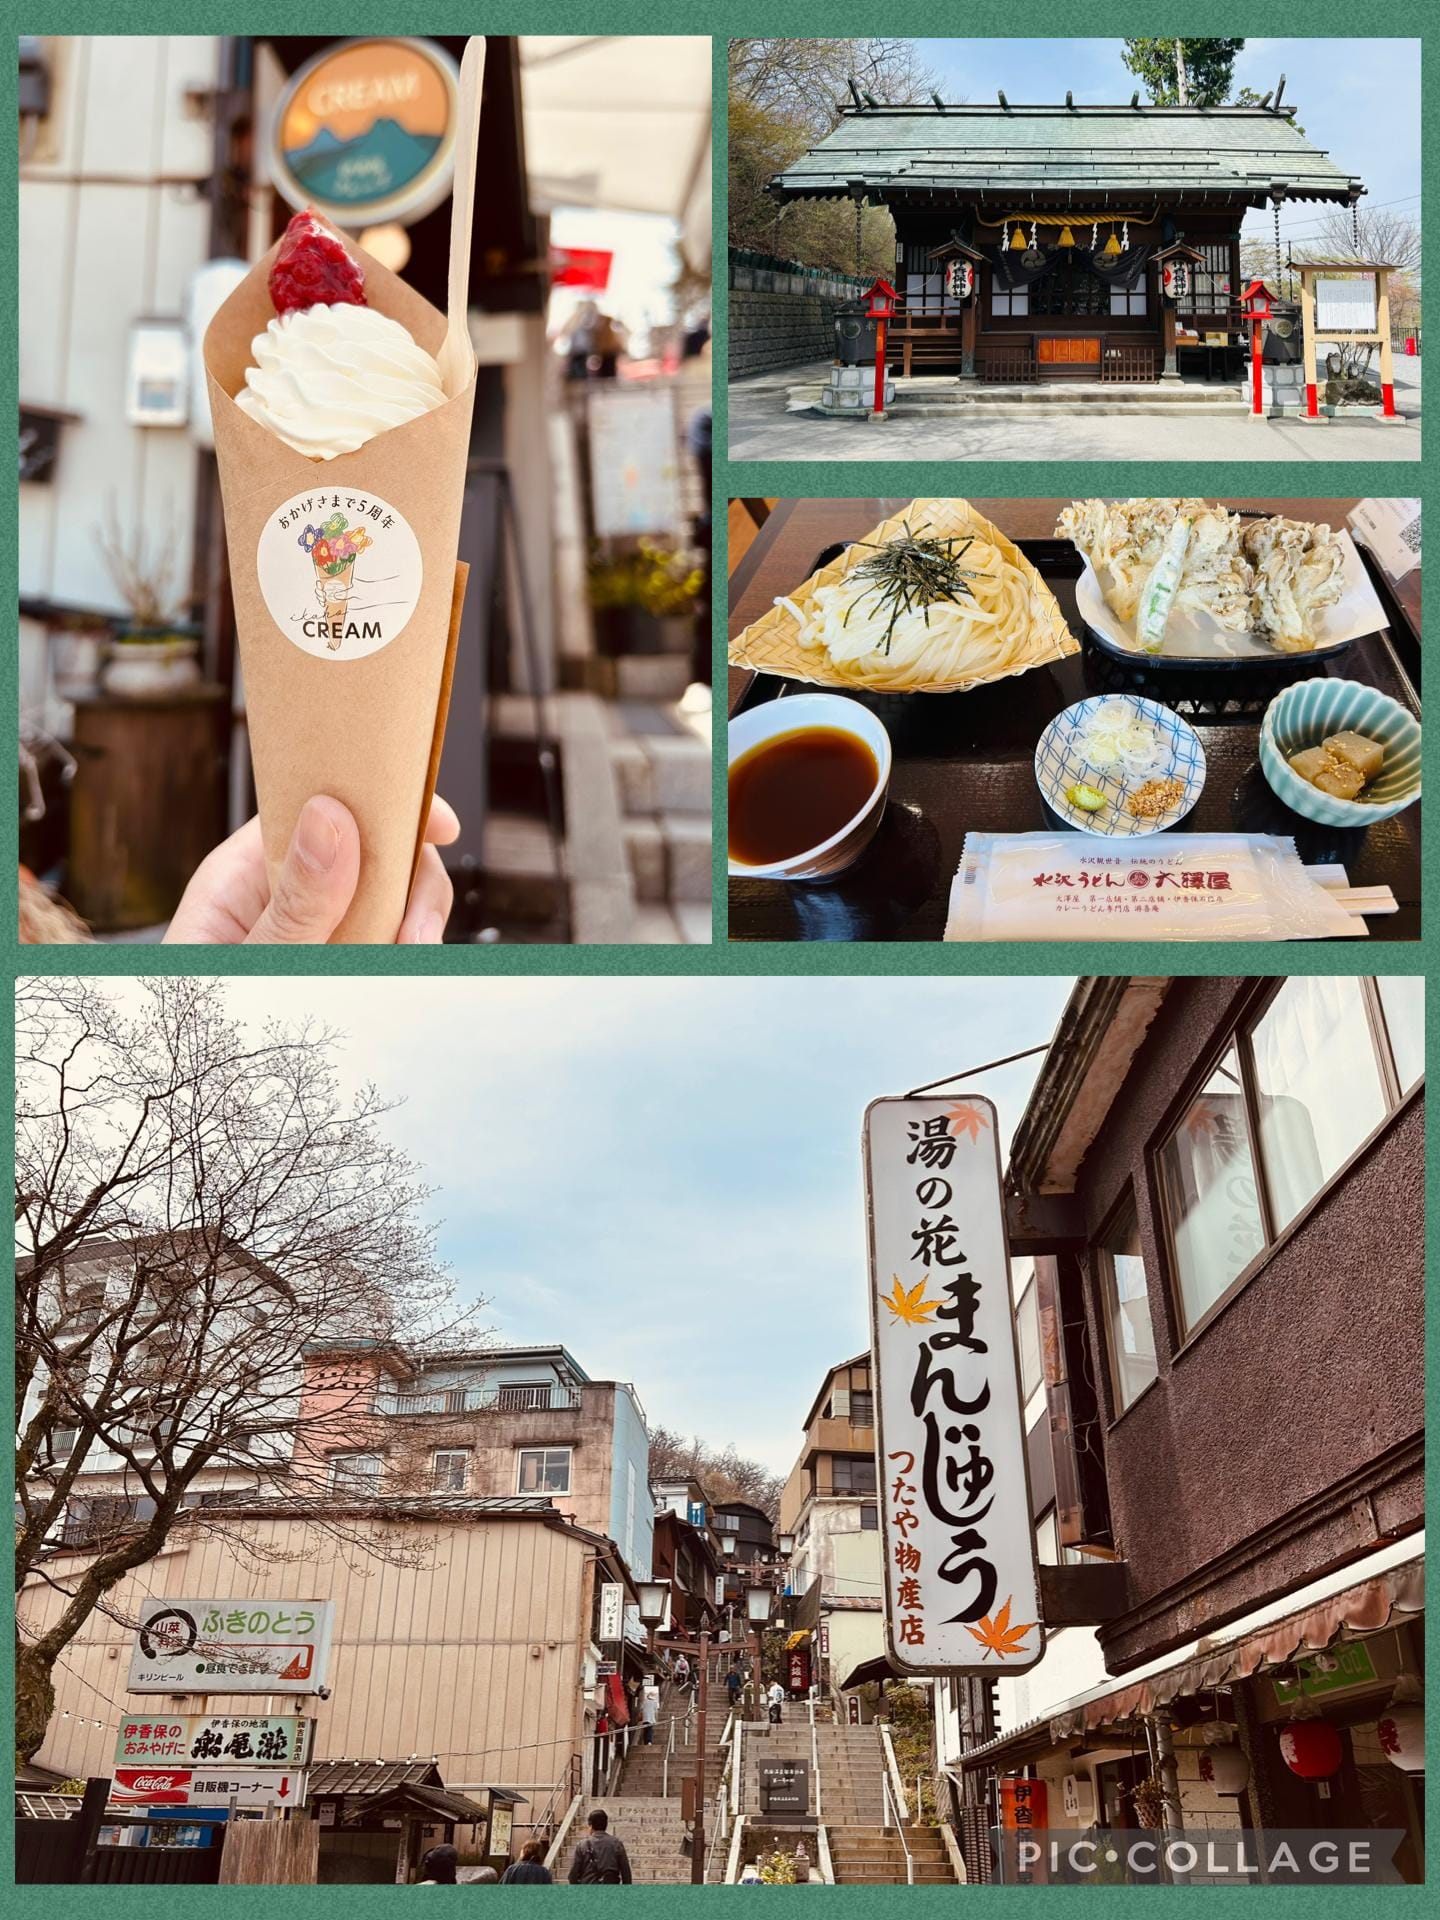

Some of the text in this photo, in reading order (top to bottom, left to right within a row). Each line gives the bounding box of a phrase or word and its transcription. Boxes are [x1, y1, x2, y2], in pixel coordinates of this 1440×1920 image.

[307, 69, 421, 117] CREAM
[278, 494, 396, 530] おかげさまで5周年
[302, 620, 383, 640] CREAM
[1032, 872, 1126, 888] 水沢うどん
[888, 1451, 925, 1646] つたや物産店
[202, 1609, 316, 1635] ふきのとう
[137, 1673, 185, 1682] キリンビール
[123, 1723, 183, 1740] 伊香保の
[210, 1718, 269, 1729] 伊香保の地酒
[123, 1741, 186, 1756] おみやげに
[193, 1780, 274, 1794] 自販機コーナー
